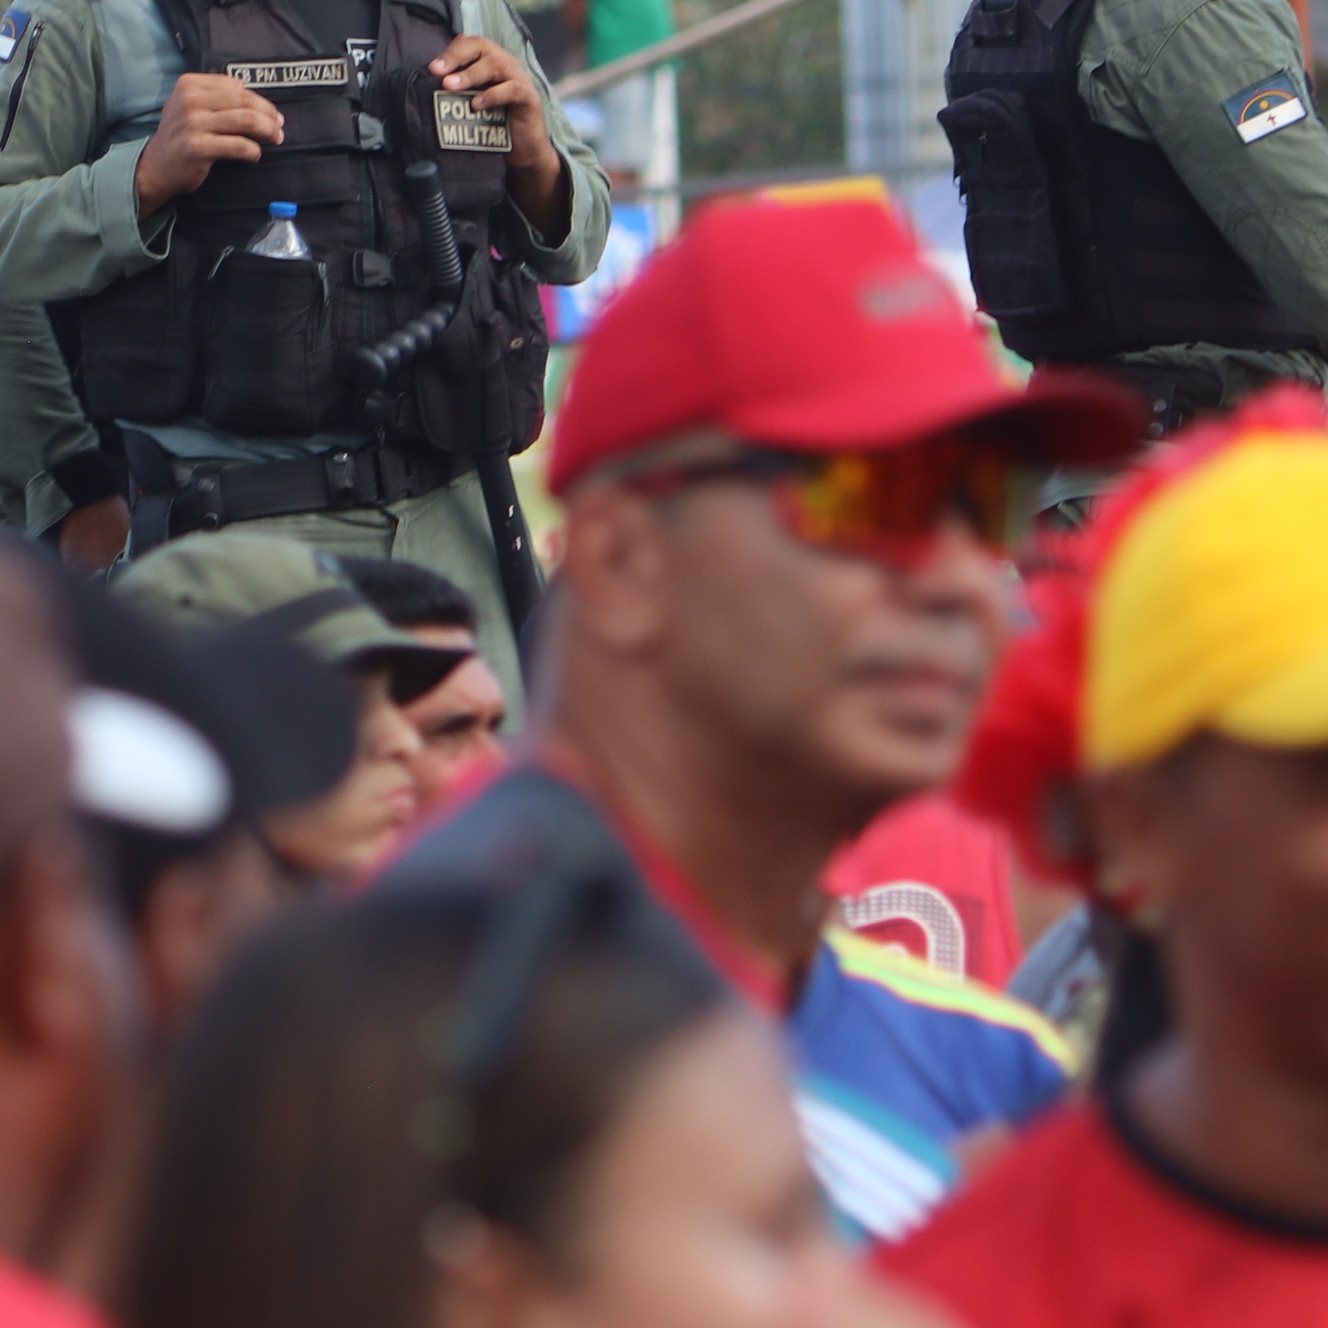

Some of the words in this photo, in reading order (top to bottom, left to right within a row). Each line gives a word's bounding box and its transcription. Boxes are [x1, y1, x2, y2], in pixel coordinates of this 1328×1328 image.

[255, 67, 278, 83] PM
[282, 63, 343, 82] LUZIVAN
[442, 124, 507, 147] MILITAR
